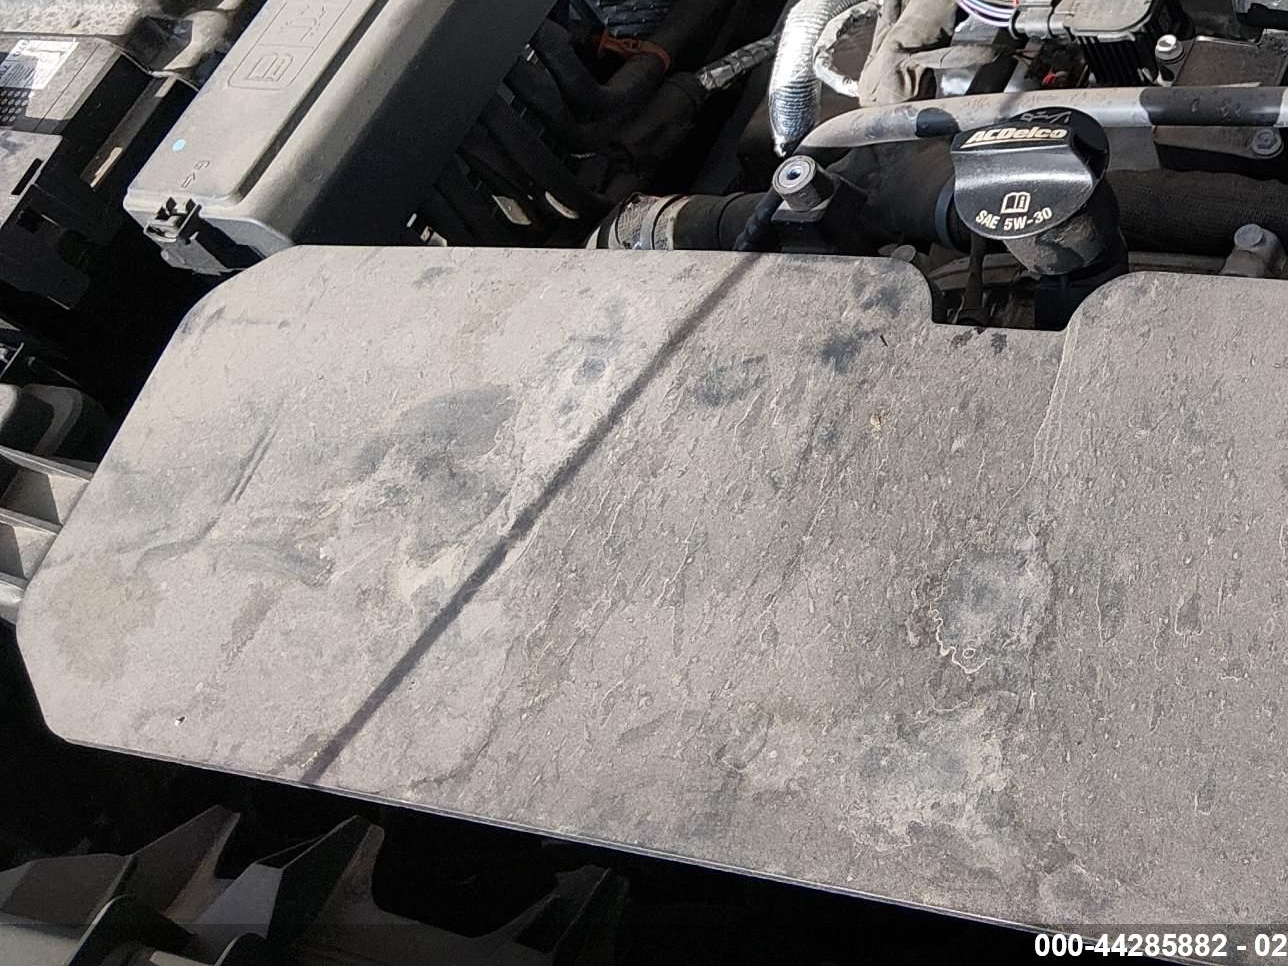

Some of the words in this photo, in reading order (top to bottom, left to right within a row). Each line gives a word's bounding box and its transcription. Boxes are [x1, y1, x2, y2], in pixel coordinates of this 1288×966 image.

[962, 126, 1068, 146] ACDelco
[975, 210, 1000, 230] SAE
[1003, 207, 1053, 231] 5W-30
